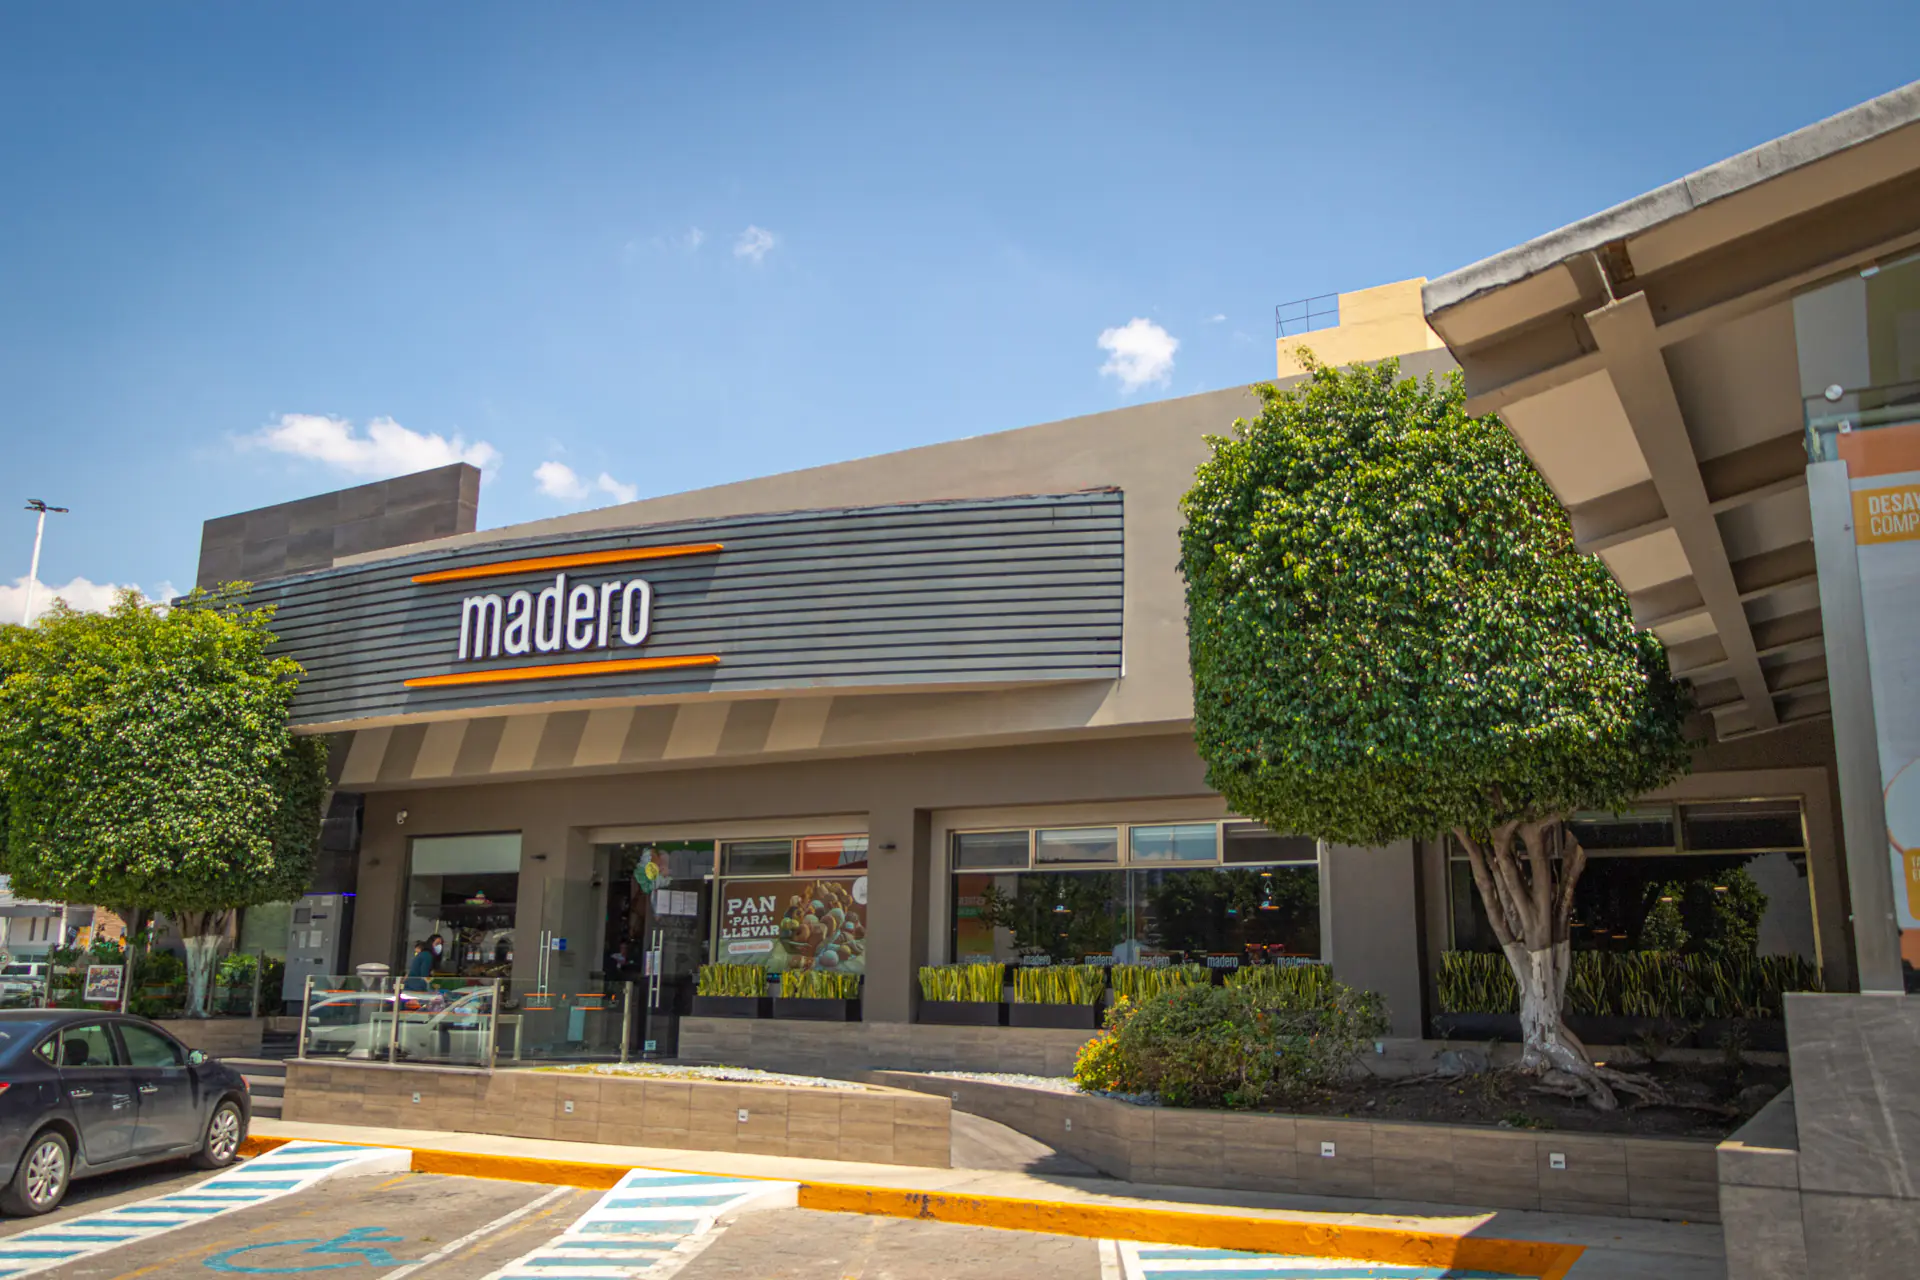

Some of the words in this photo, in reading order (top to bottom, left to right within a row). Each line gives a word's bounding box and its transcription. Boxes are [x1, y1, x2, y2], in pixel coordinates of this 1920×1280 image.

[1870, 512, 1920, 536] COMP
[458, 573, 652, 660] madero
[727, 895, 776, 915] PAN
[732, 914, 769, 926] PARA
[722, 925, 780, 938] LLEVAR
[1023, 954, 1051, 965] madero
[1084, 954, 1114, 965] madero
[1207, 955, 1239, 967] madero
